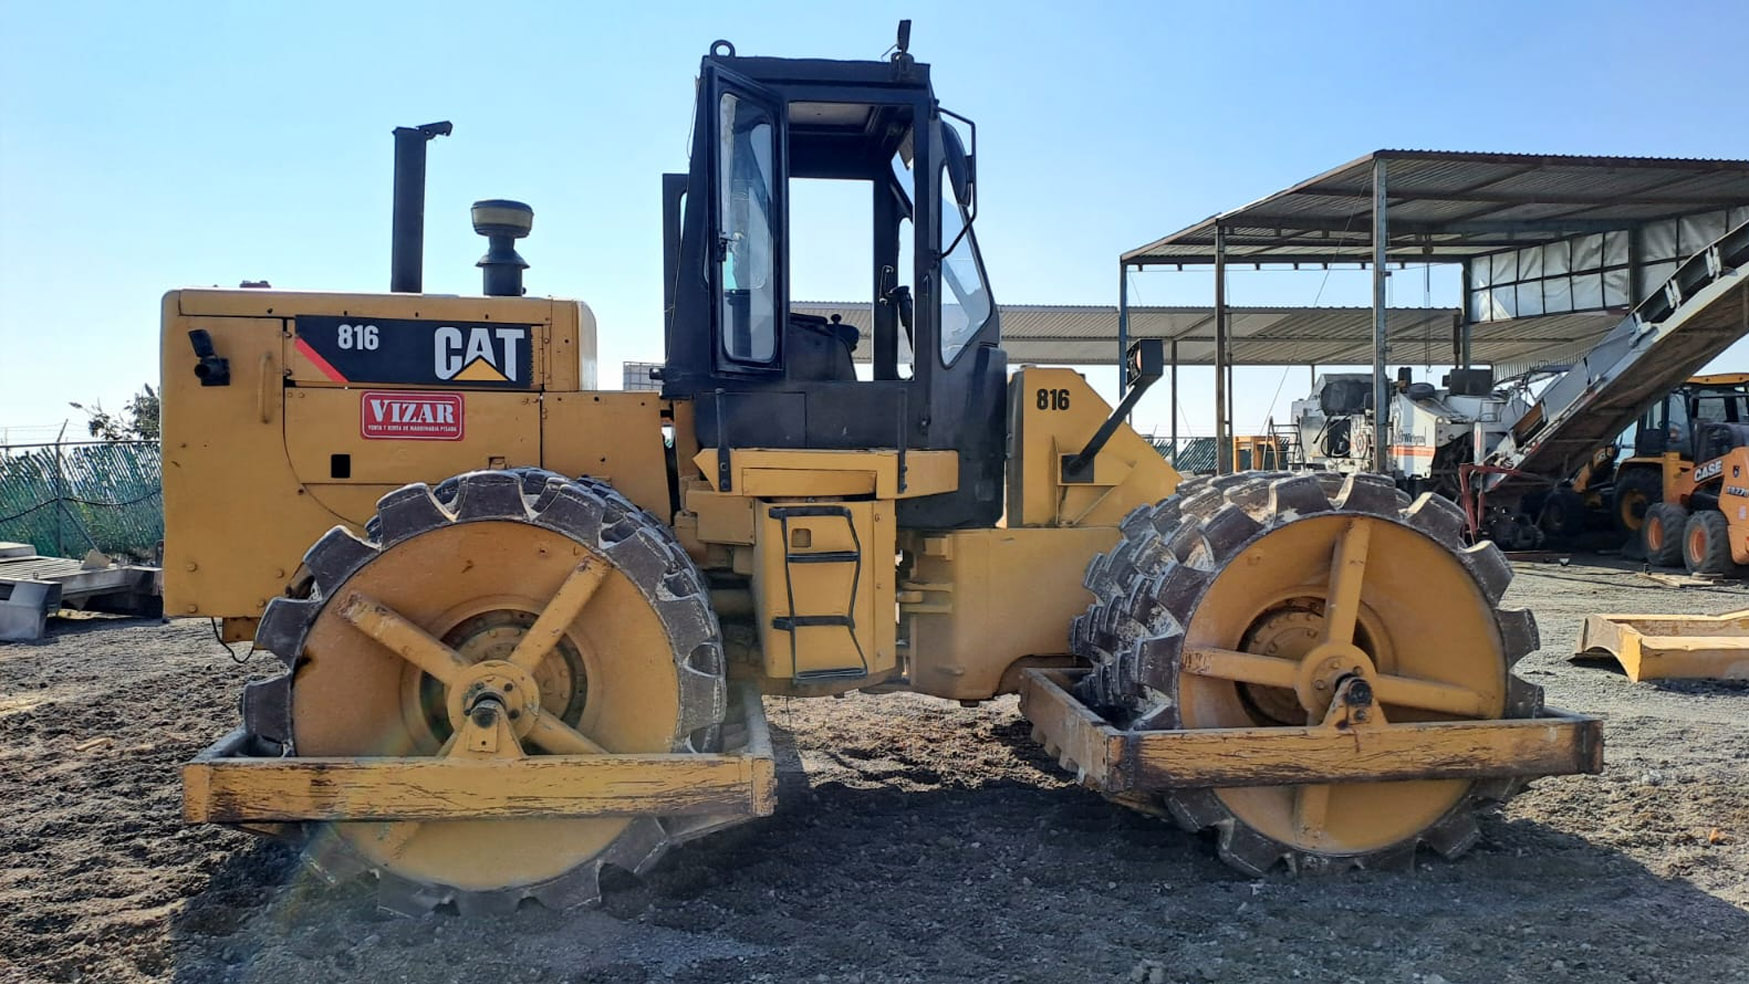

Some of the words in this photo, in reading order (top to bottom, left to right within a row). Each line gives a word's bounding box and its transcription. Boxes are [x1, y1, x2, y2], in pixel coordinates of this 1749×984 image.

[337, 324, 380, 351] 816
[434, 326, 525, 382] CAT
[370, 399, 456, 424] VIZAR
[1036, 388, 1070, 411] 816
[1694, 460, 1723, 482] CASE
